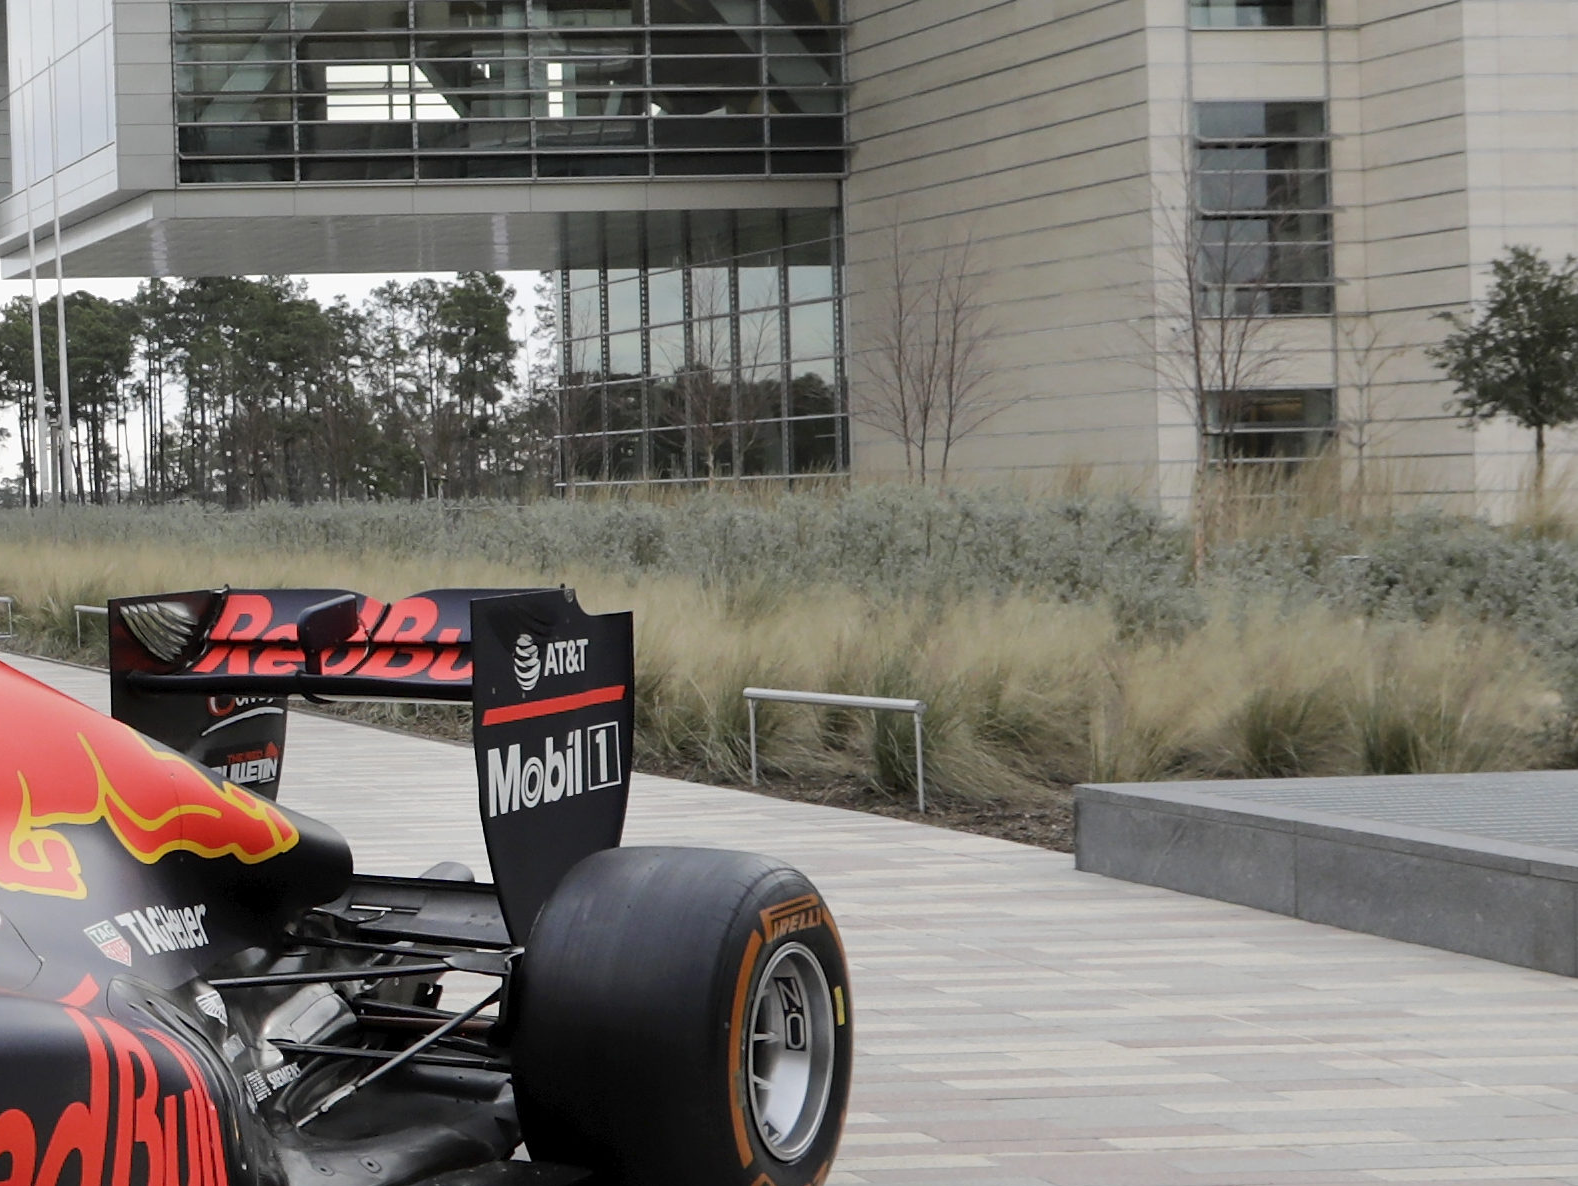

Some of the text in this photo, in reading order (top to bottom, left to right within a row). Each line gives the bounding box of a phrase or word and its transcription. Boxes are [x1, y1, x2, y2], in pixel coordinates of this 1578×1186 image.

[544, 638, 588, 677] AT&T
[487, 729, 583, 818] Mobil
[759, 893, 823, 944] PIRELLI
